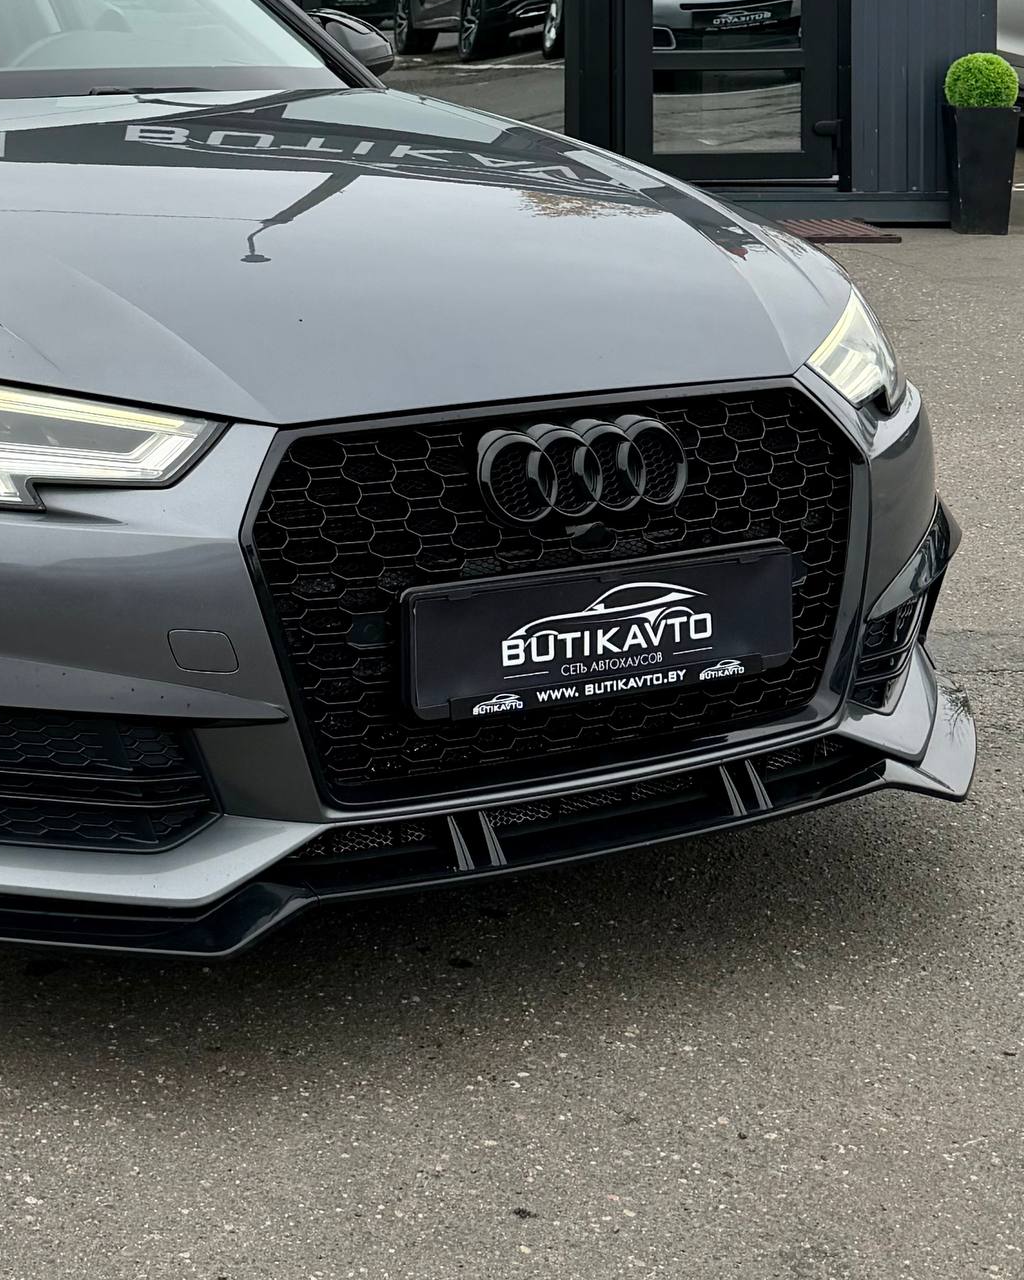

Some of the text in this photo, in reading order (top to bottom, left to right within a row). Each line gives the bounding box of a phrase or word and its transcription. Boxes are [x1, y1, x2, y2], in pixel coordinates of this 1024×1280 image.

[502, 612, 713, 668] BUTIKAVTO
[561, 651, 664, 677] СЕТЬ АВТОХАУСОВ
[699, 666, 745, 681] BUTIKAVTO
[536, 669, 687, 703] WWW. BUTIKAVTO.BY
[472, 701, 524, 715] BUTIKAVTO
